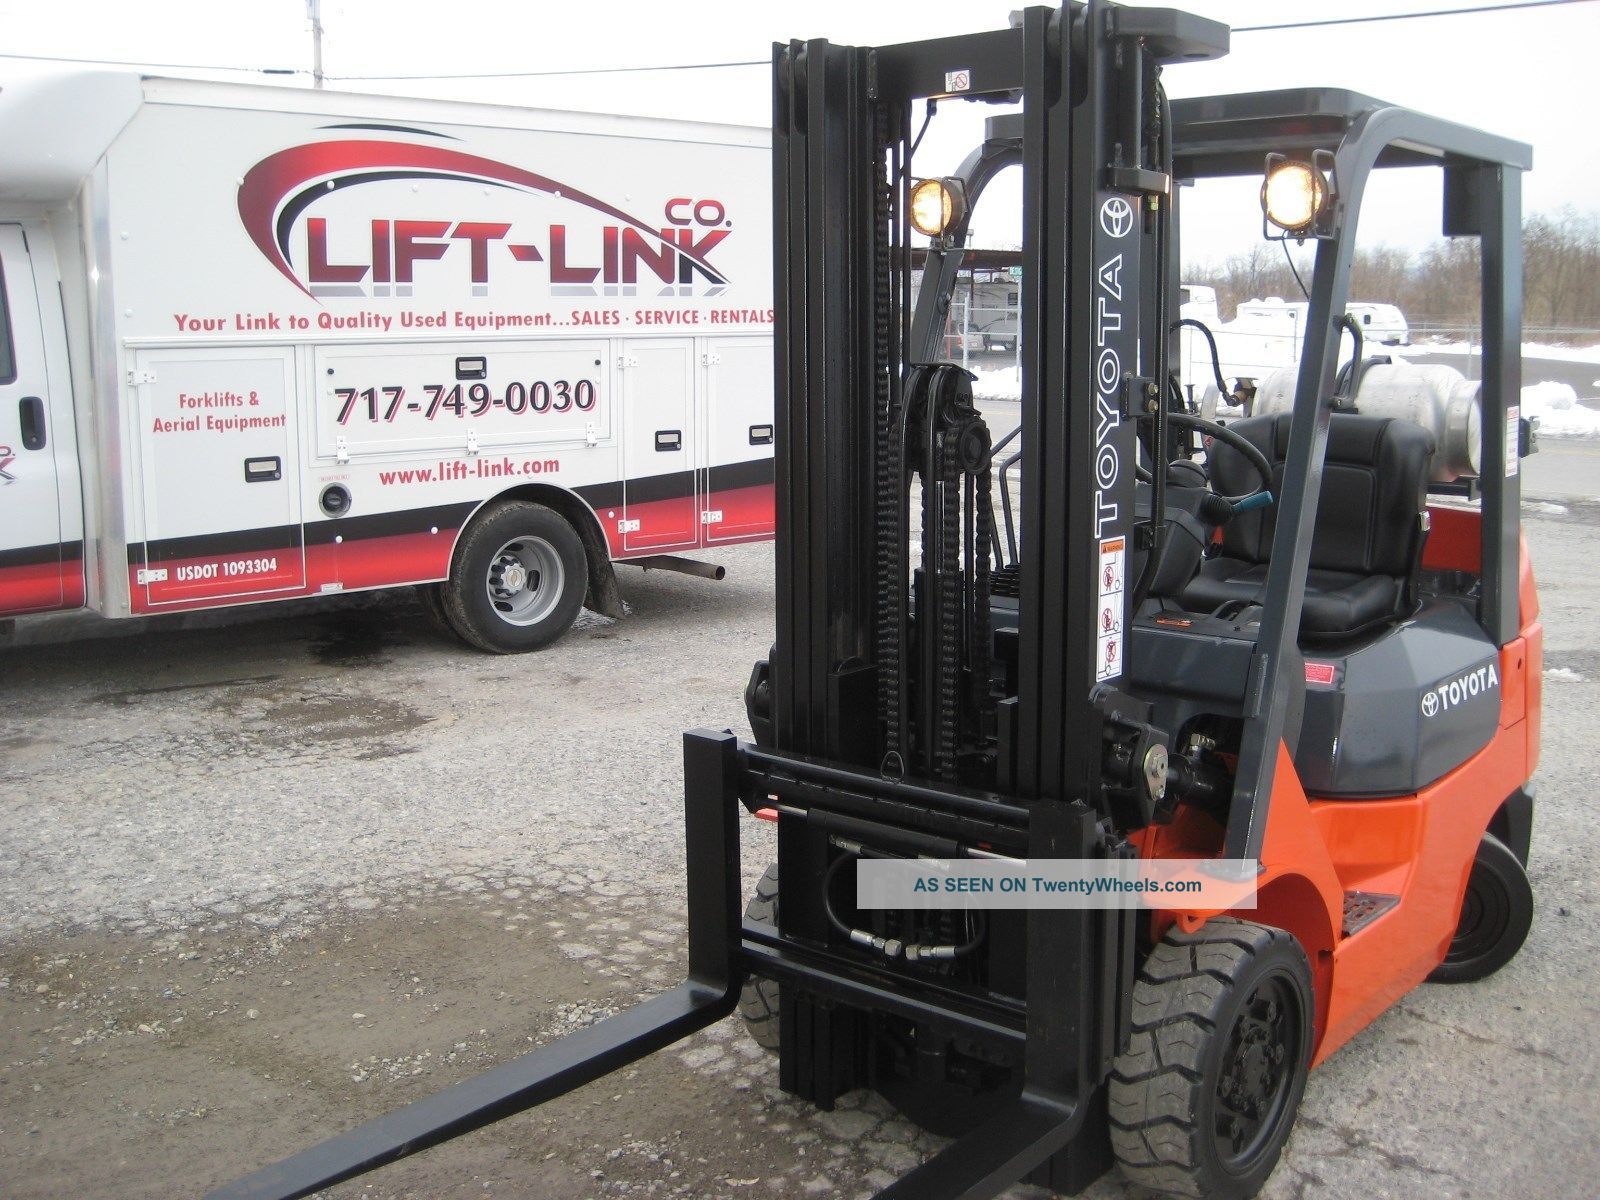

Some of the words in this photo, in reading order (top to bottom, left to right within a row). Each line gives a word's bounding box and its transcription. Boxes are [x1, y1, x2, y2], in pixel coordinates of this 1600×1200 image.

[665, 197, 732, 228] CO.
[306, 217, 732, 285] LIFT-LINK
[174, 314, 226, 331] Your
[235, 313, 281, 330] Link
[288, 314, 310, 330] to
[318, 312, 392, 332] Quality
[400, 311, 447, 328] Used
[635, 309, 700, 325] SERVICE
[710, 309, 774, 324] RENTALS
[179, 392, 244, 409] Forklifts
[248, 390, 260, 407] &
[334, 379, 597, 426] 717-749-0030
[1094, 253, 1123, 539] TOYOTA
[153, 416, 202, 433] Aerial
[205, 413, 287, 432] Equipment
[379, 457, 560, 486] www.lift-link.com
[177, 564, 219, 581] USDOT
[223, 557, 277, 576] 1093304
[1438, 664, 1499, 710] TOYOTA
